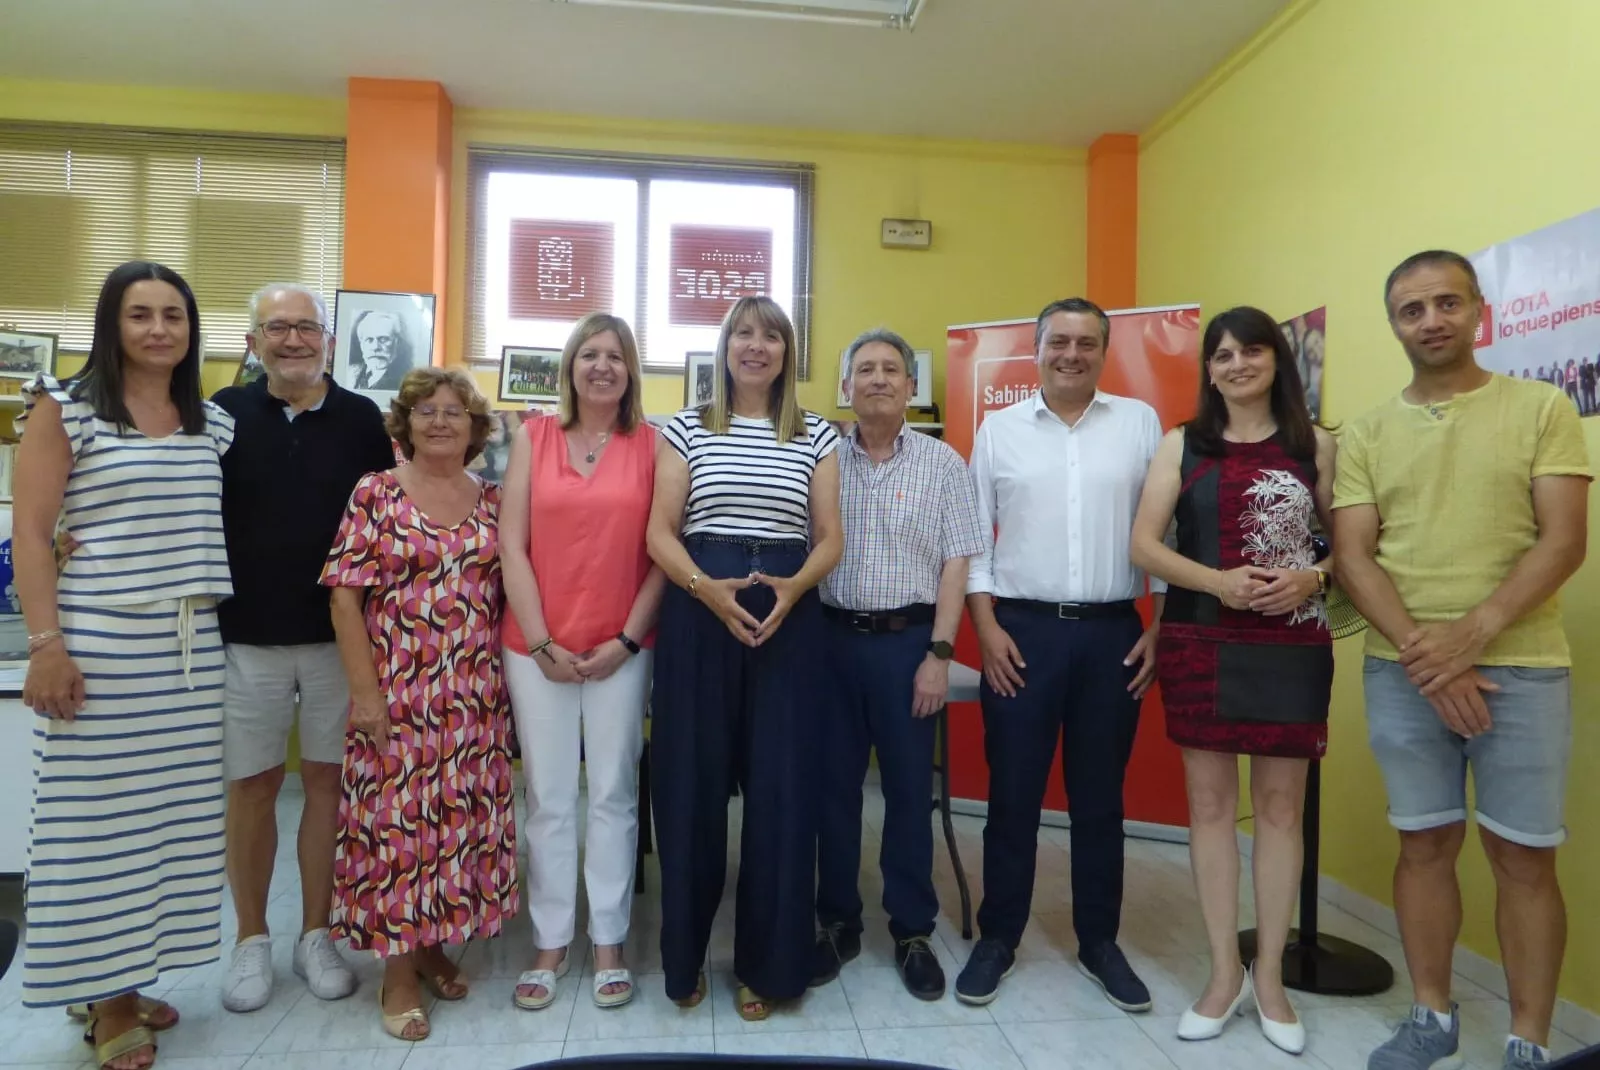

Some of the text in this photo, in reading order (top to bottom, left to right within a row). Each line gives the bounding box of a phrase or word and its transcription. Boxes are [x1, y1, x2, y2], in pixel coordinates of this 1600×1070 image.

[1500, 291, 1550, 319] VOTA
[1499, 322, 1513, 339] lo
[1516, 314, 1549, 337] que
